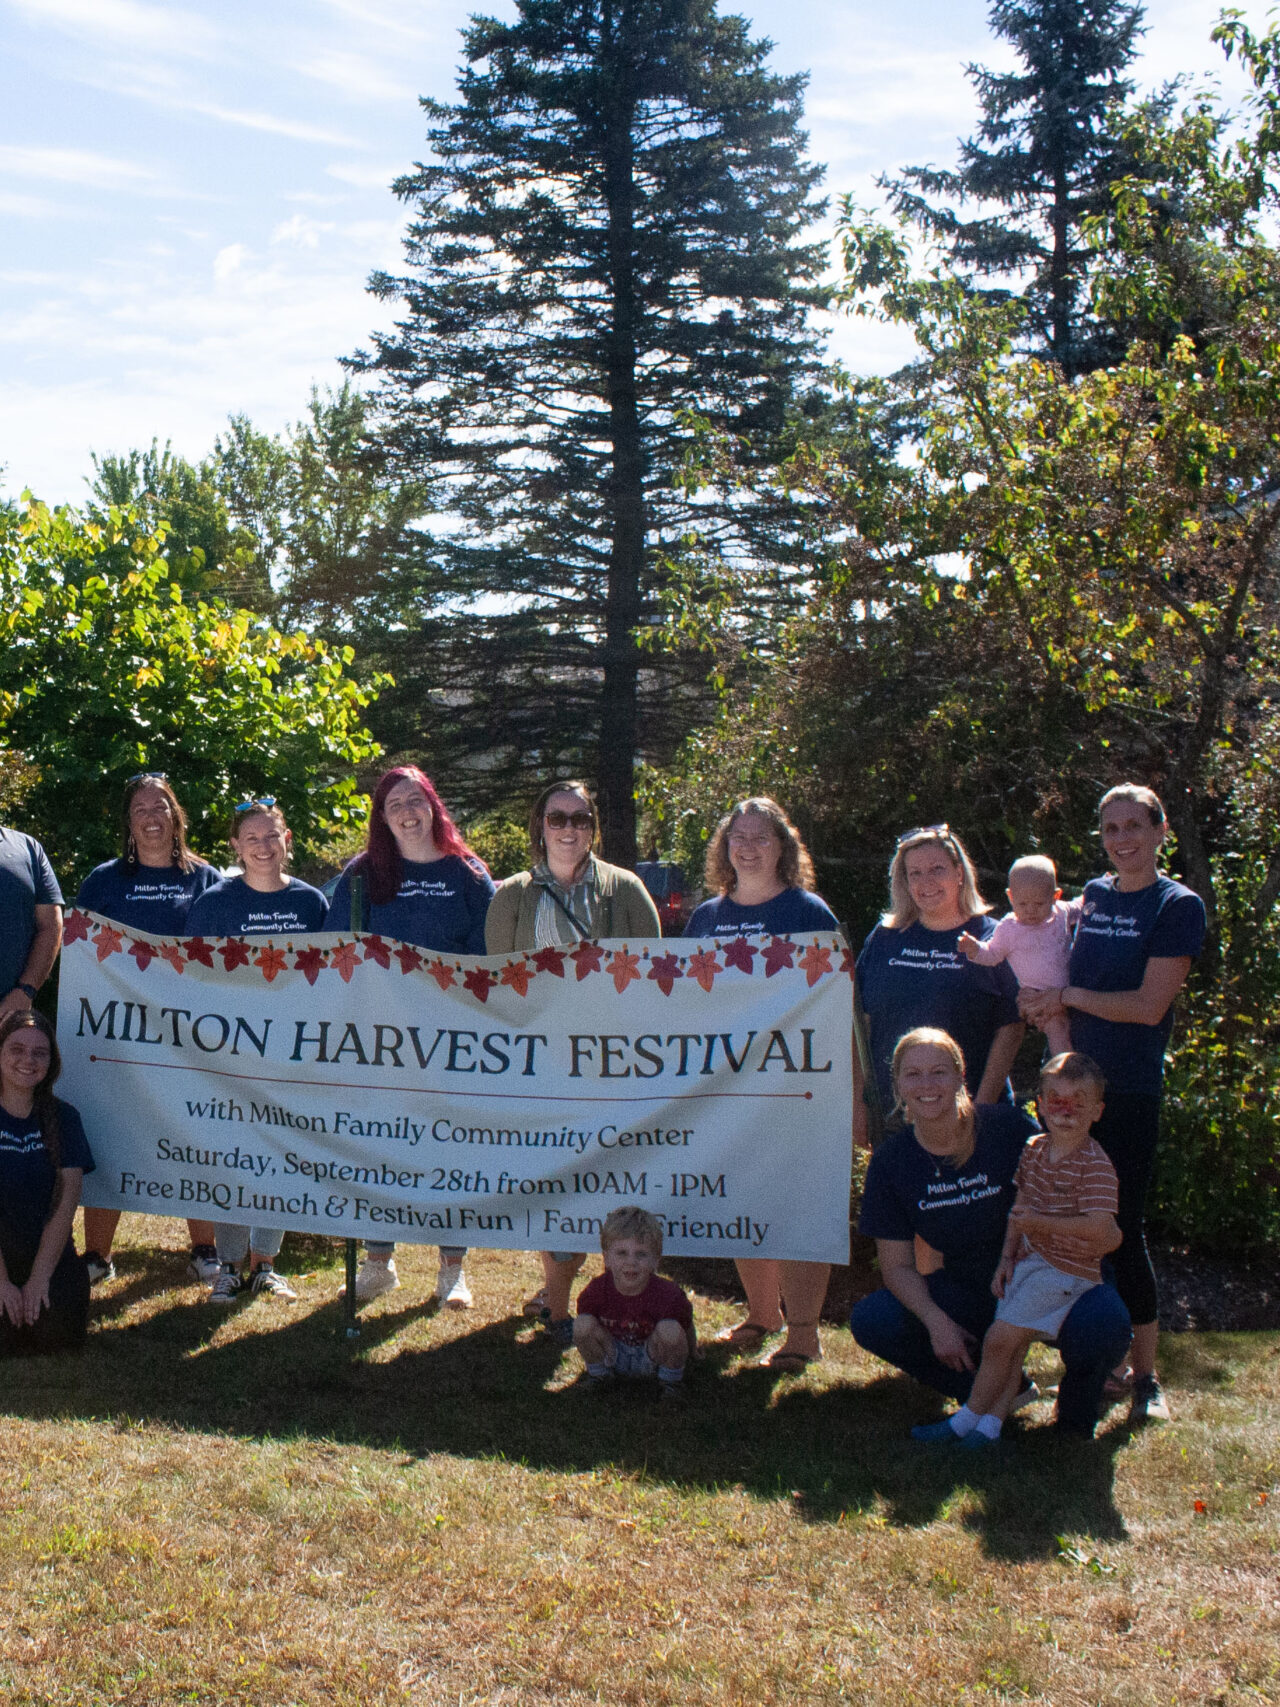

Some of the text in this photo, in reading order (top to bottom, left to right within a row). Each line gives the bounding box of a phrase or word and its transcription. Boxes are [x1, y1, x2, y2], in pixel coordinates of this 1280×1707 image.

[396, 889, 429, 897] ommunity
[76, 997, 832, 1078] MILTON HARVEST FESTIVAL
[186, 1097, 695, 1153] with Milton Family Community Center
[157, 1138, 276, 1177] Saturday,
[283, 1152, 425, 1189] September
[430, 1168, 490, 1193] 28th
[496, 1172, 566, 1194] from
[571, 1171, 648, 1196] 10AM
[669, 1172, 727, 1198] 1PM
[120, 1171, 174, 1199] Free
[179, 1179, 232, 1210] BBQ
[236, 1186, 318, 1216] Lunch
[324, 1195, 349, 1219] &
[353, 1198, 453, 1230] Festival
[458, 1209, 513, 1232] Fun
[543, 1209, 602, 1235] Fam
